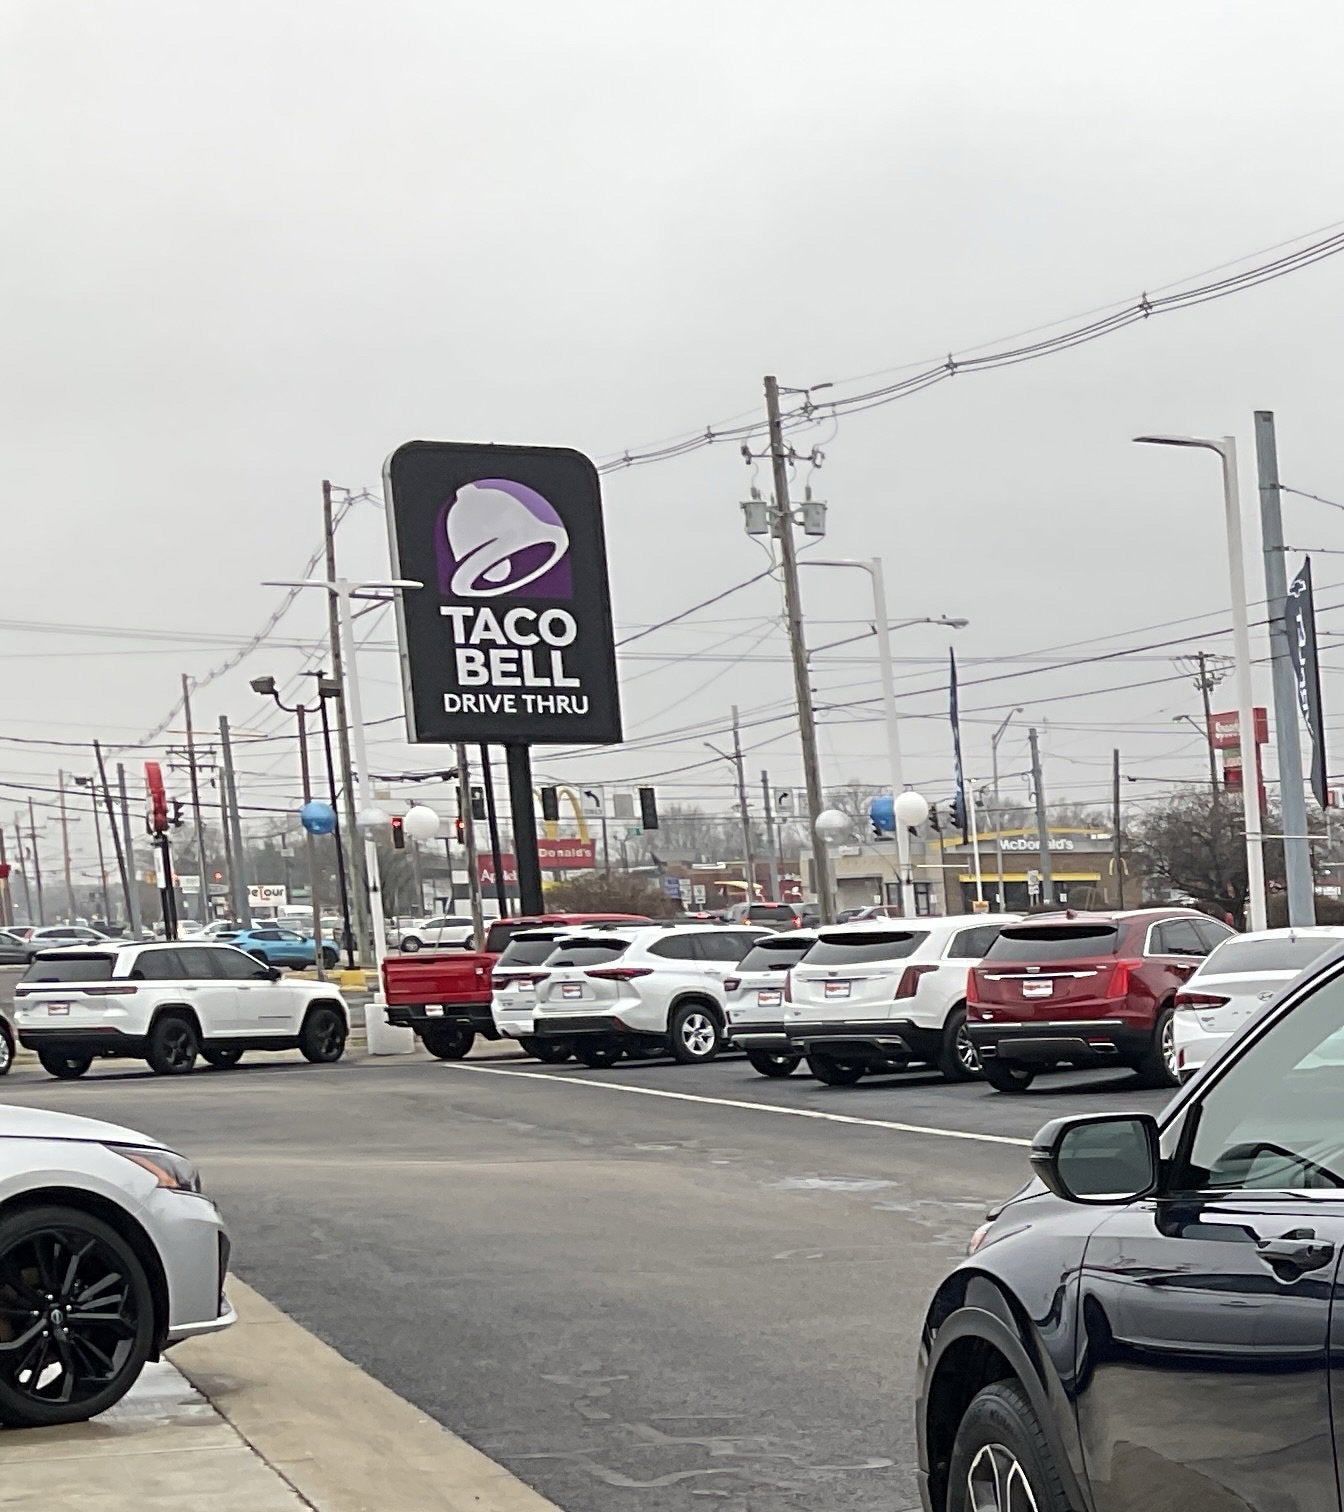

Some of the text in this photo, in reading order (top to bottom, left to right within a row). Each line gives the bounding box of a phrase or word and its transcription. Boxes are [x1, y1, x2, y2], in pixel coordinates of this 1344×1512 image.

[440, 606, 578, 647] TACO
[455, 648, 581, 688] BELL
[443, 693, 589, 714] DRIVE THRU
[538, 847, 593, 858] Donald's
